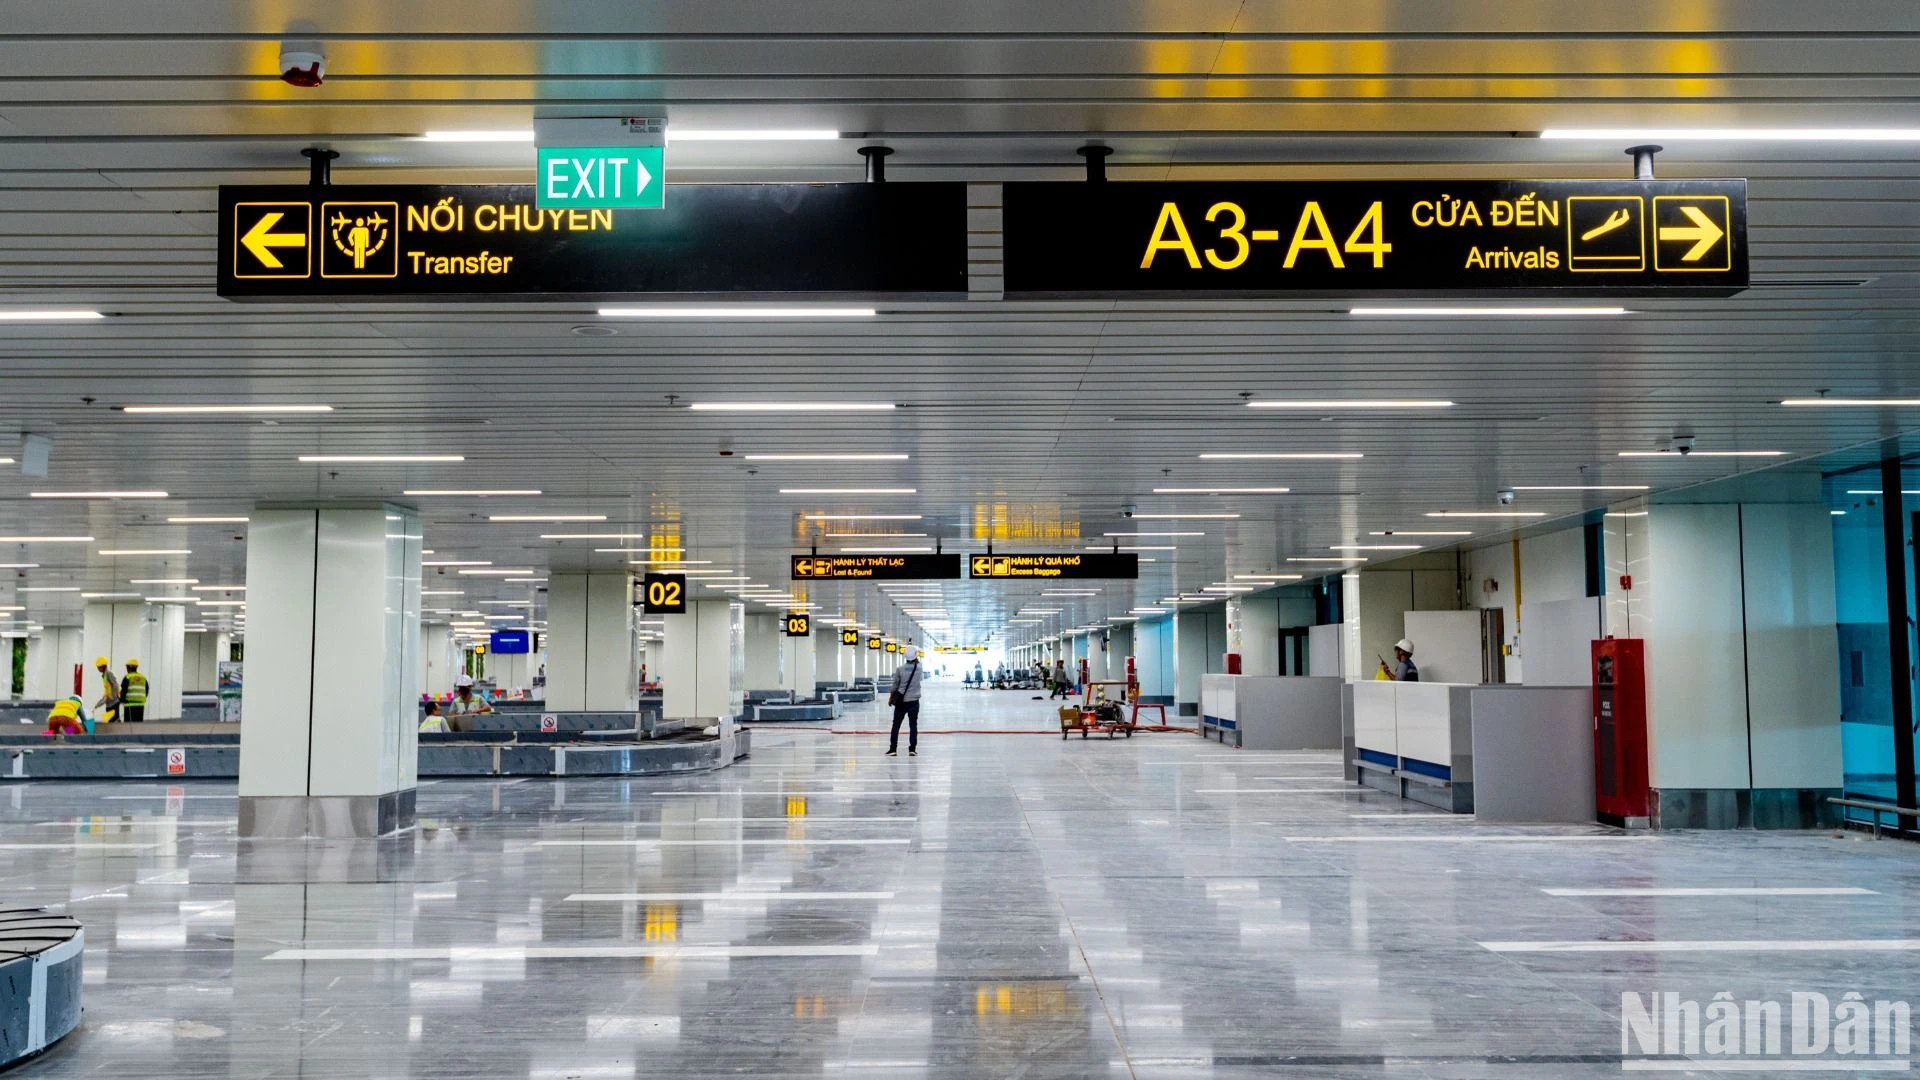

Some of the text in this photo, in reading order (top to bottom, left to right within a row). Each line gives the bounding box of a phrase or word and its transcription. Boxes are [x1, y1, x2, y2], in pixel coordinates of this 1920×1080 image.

[547, 158, 628, 198] EXIT
[407, 197, 463, 231] NỐI
[1411, 192, 1559, 226] CỬA ĐẾN
[1140, 201, 1392, 269] A3-A4
[407, 251, 513, 274] Transfer
[1465, 246, 1560, 268] Arrivals
[649, 581, 681, 606] 02
[788, 618, 807, 633] 03
[844, 632, 857, 643] 04
